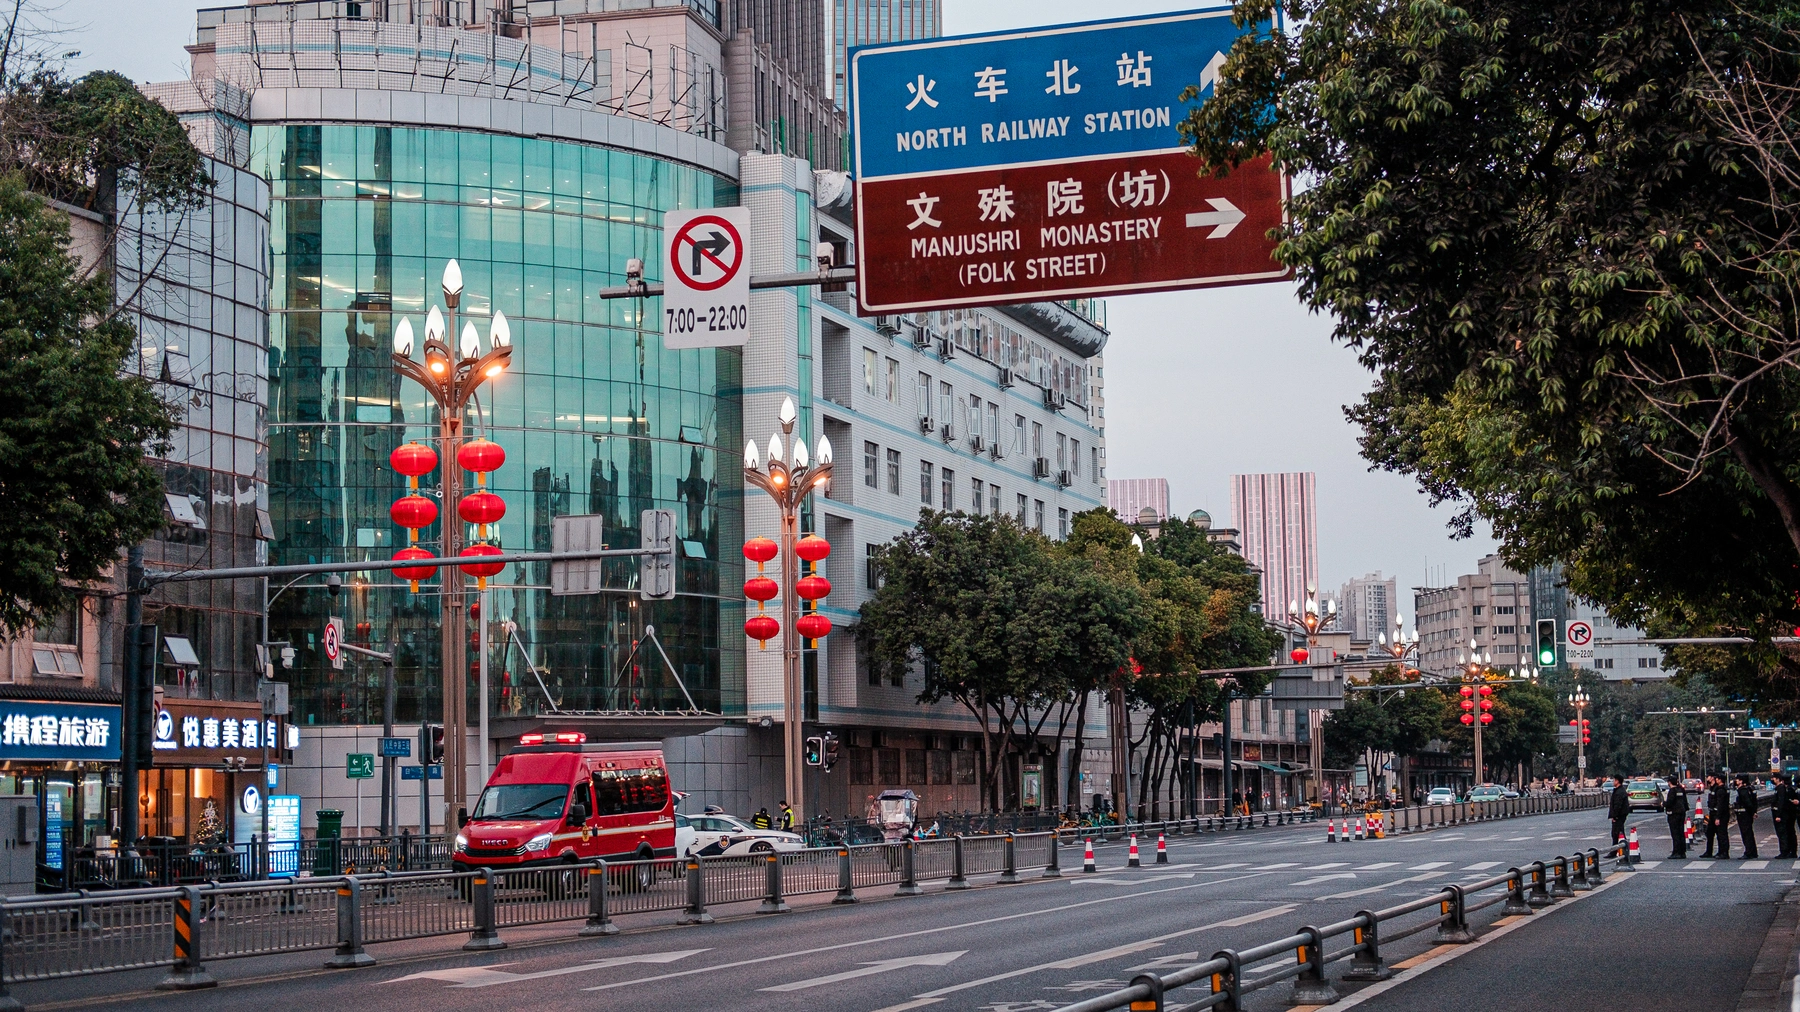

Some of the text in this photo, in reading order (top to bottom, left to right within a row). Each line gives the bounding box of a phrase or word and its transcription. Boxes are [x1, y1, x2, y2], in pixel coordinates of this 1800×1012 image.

[905, 50, 1153, 111] 火车北站
[896, 106, 1170, 152] NORTH RAILWAY STATION
[911, 216, 1162, 259] MANJUSHRI MONASTERY
[958, 252, 1106, 287] (FOLK STREET)
[3, 713, 110, 747] 携程旅游
[183, 716, 276, 748] 悦惠美酒店
